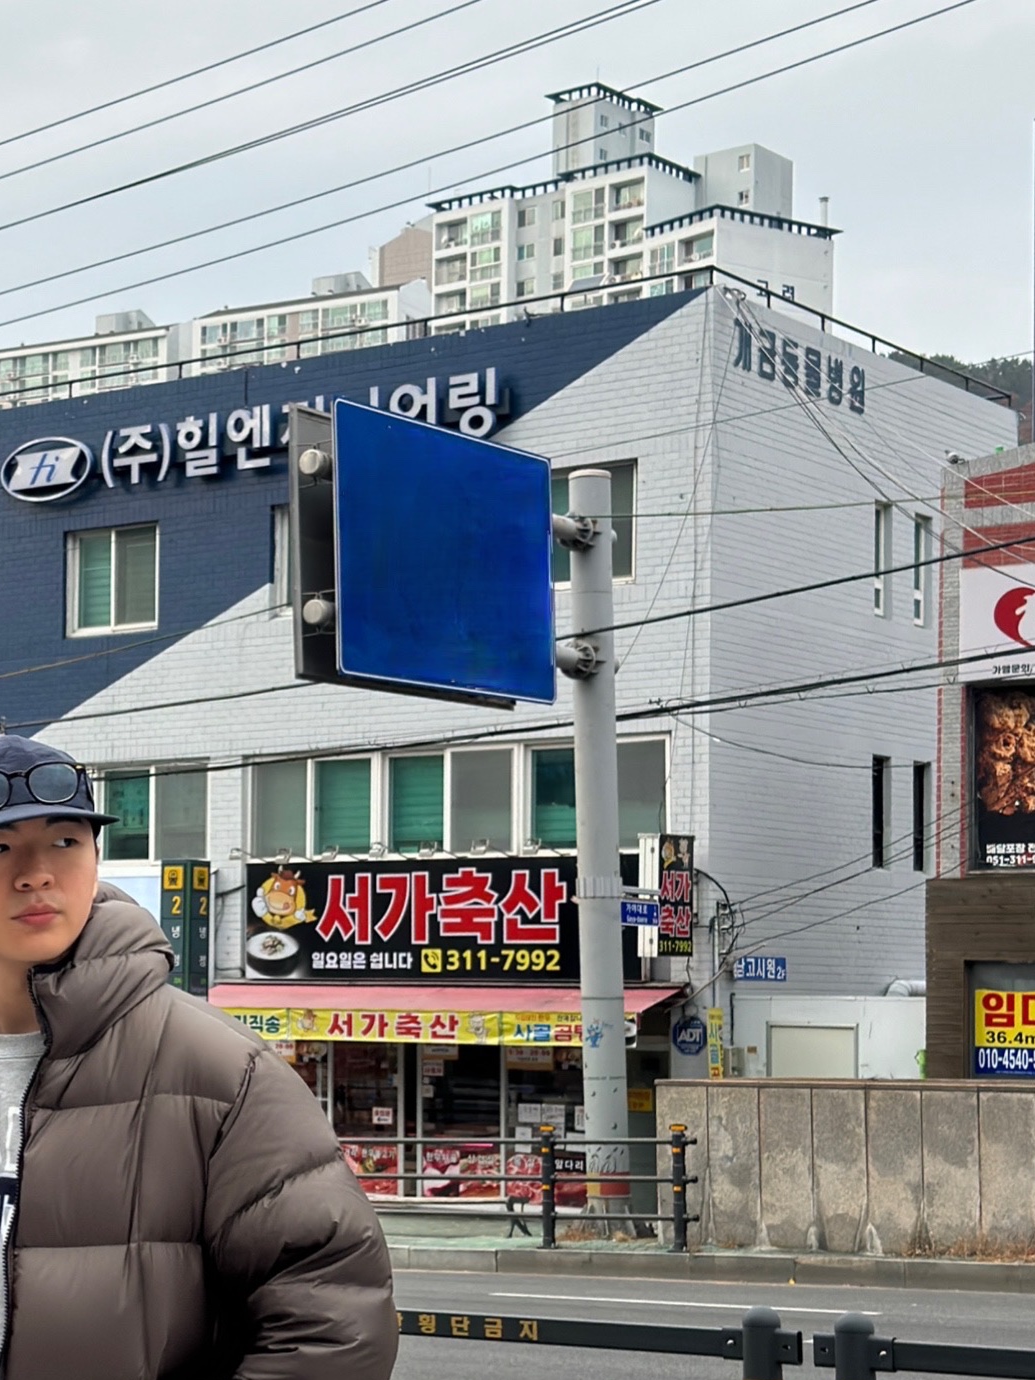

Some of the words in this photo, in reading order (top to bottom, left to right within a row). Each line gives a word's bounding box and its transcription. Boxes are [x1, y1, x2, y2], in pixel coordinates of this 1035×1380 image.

[660, 870, 691, 902] 서가
[171, 895, 182, 915] 2
[199, 896, 207, 916] 2
[316, 867, 568, 945] 서가축산
[660, 904, 691, 938] 축산
[311, 952, 366, 970] 일요일은
[369, 952, 414, 970] 쉽니다
[446, 950, 561, 972] 311-7992
[776, 966, 786, 980] 2F
[328, 1012, 460, 1040] 서가축산
[514, 1023, 552, 1042] 사골
[677, 1028, 704, 1043] ADT
[978, 1048, 1035, 1071] 010-4540-
